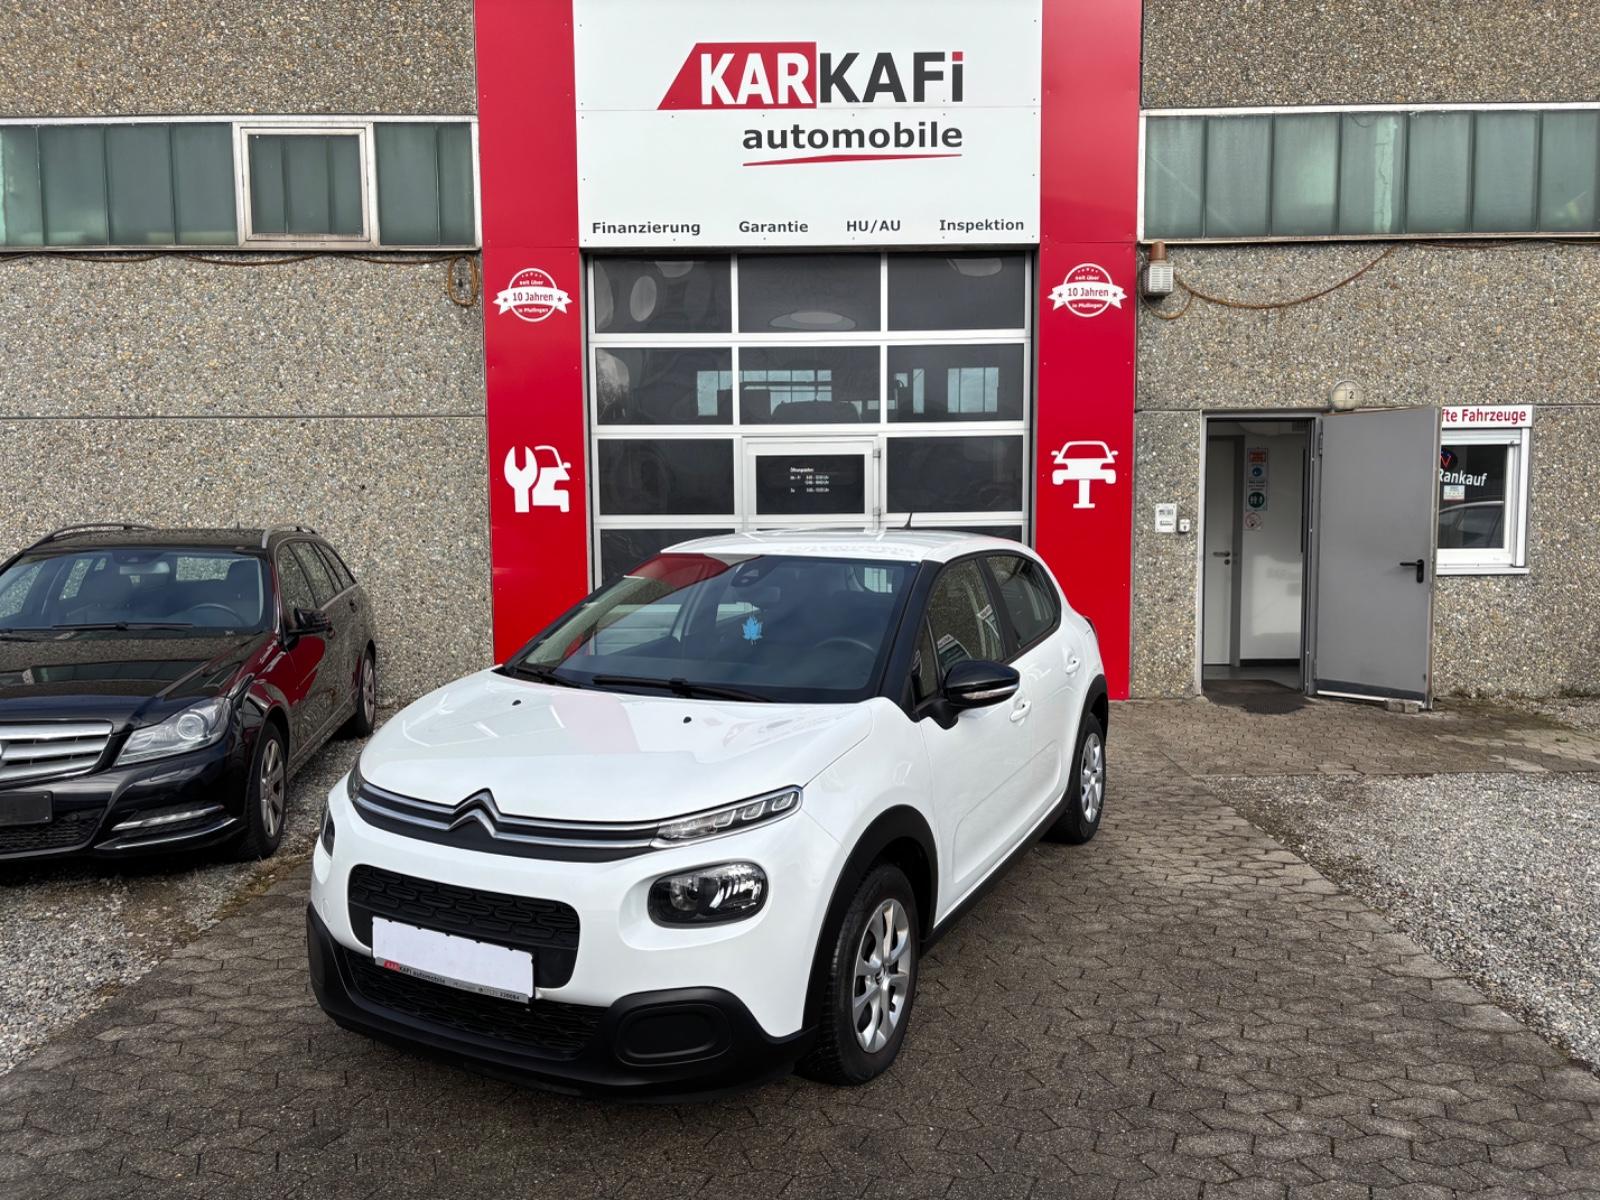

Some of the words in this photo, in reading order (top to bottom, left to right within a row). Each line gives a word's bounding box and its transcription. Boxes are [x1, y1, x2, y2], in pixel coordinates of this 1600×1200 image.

[742, 121, 963, 150] automobile
[592, 221, 701, 236] Finanzierung
[738, 219, 809, 234] Garantie
[846, 219, 901, 233] HU/AU
[939, 218, 1025, 235] Inspektion
[512, 292, 523, 302] 10
[525, 291, 554, 302] Jahren
[1067, 287, 1079, 297] 10
[1080, 287, 1109, 297] Jahren
[1349, 390, 1355, 400] 2
[1461, 408, 1527, 425] Fahrzeuge
